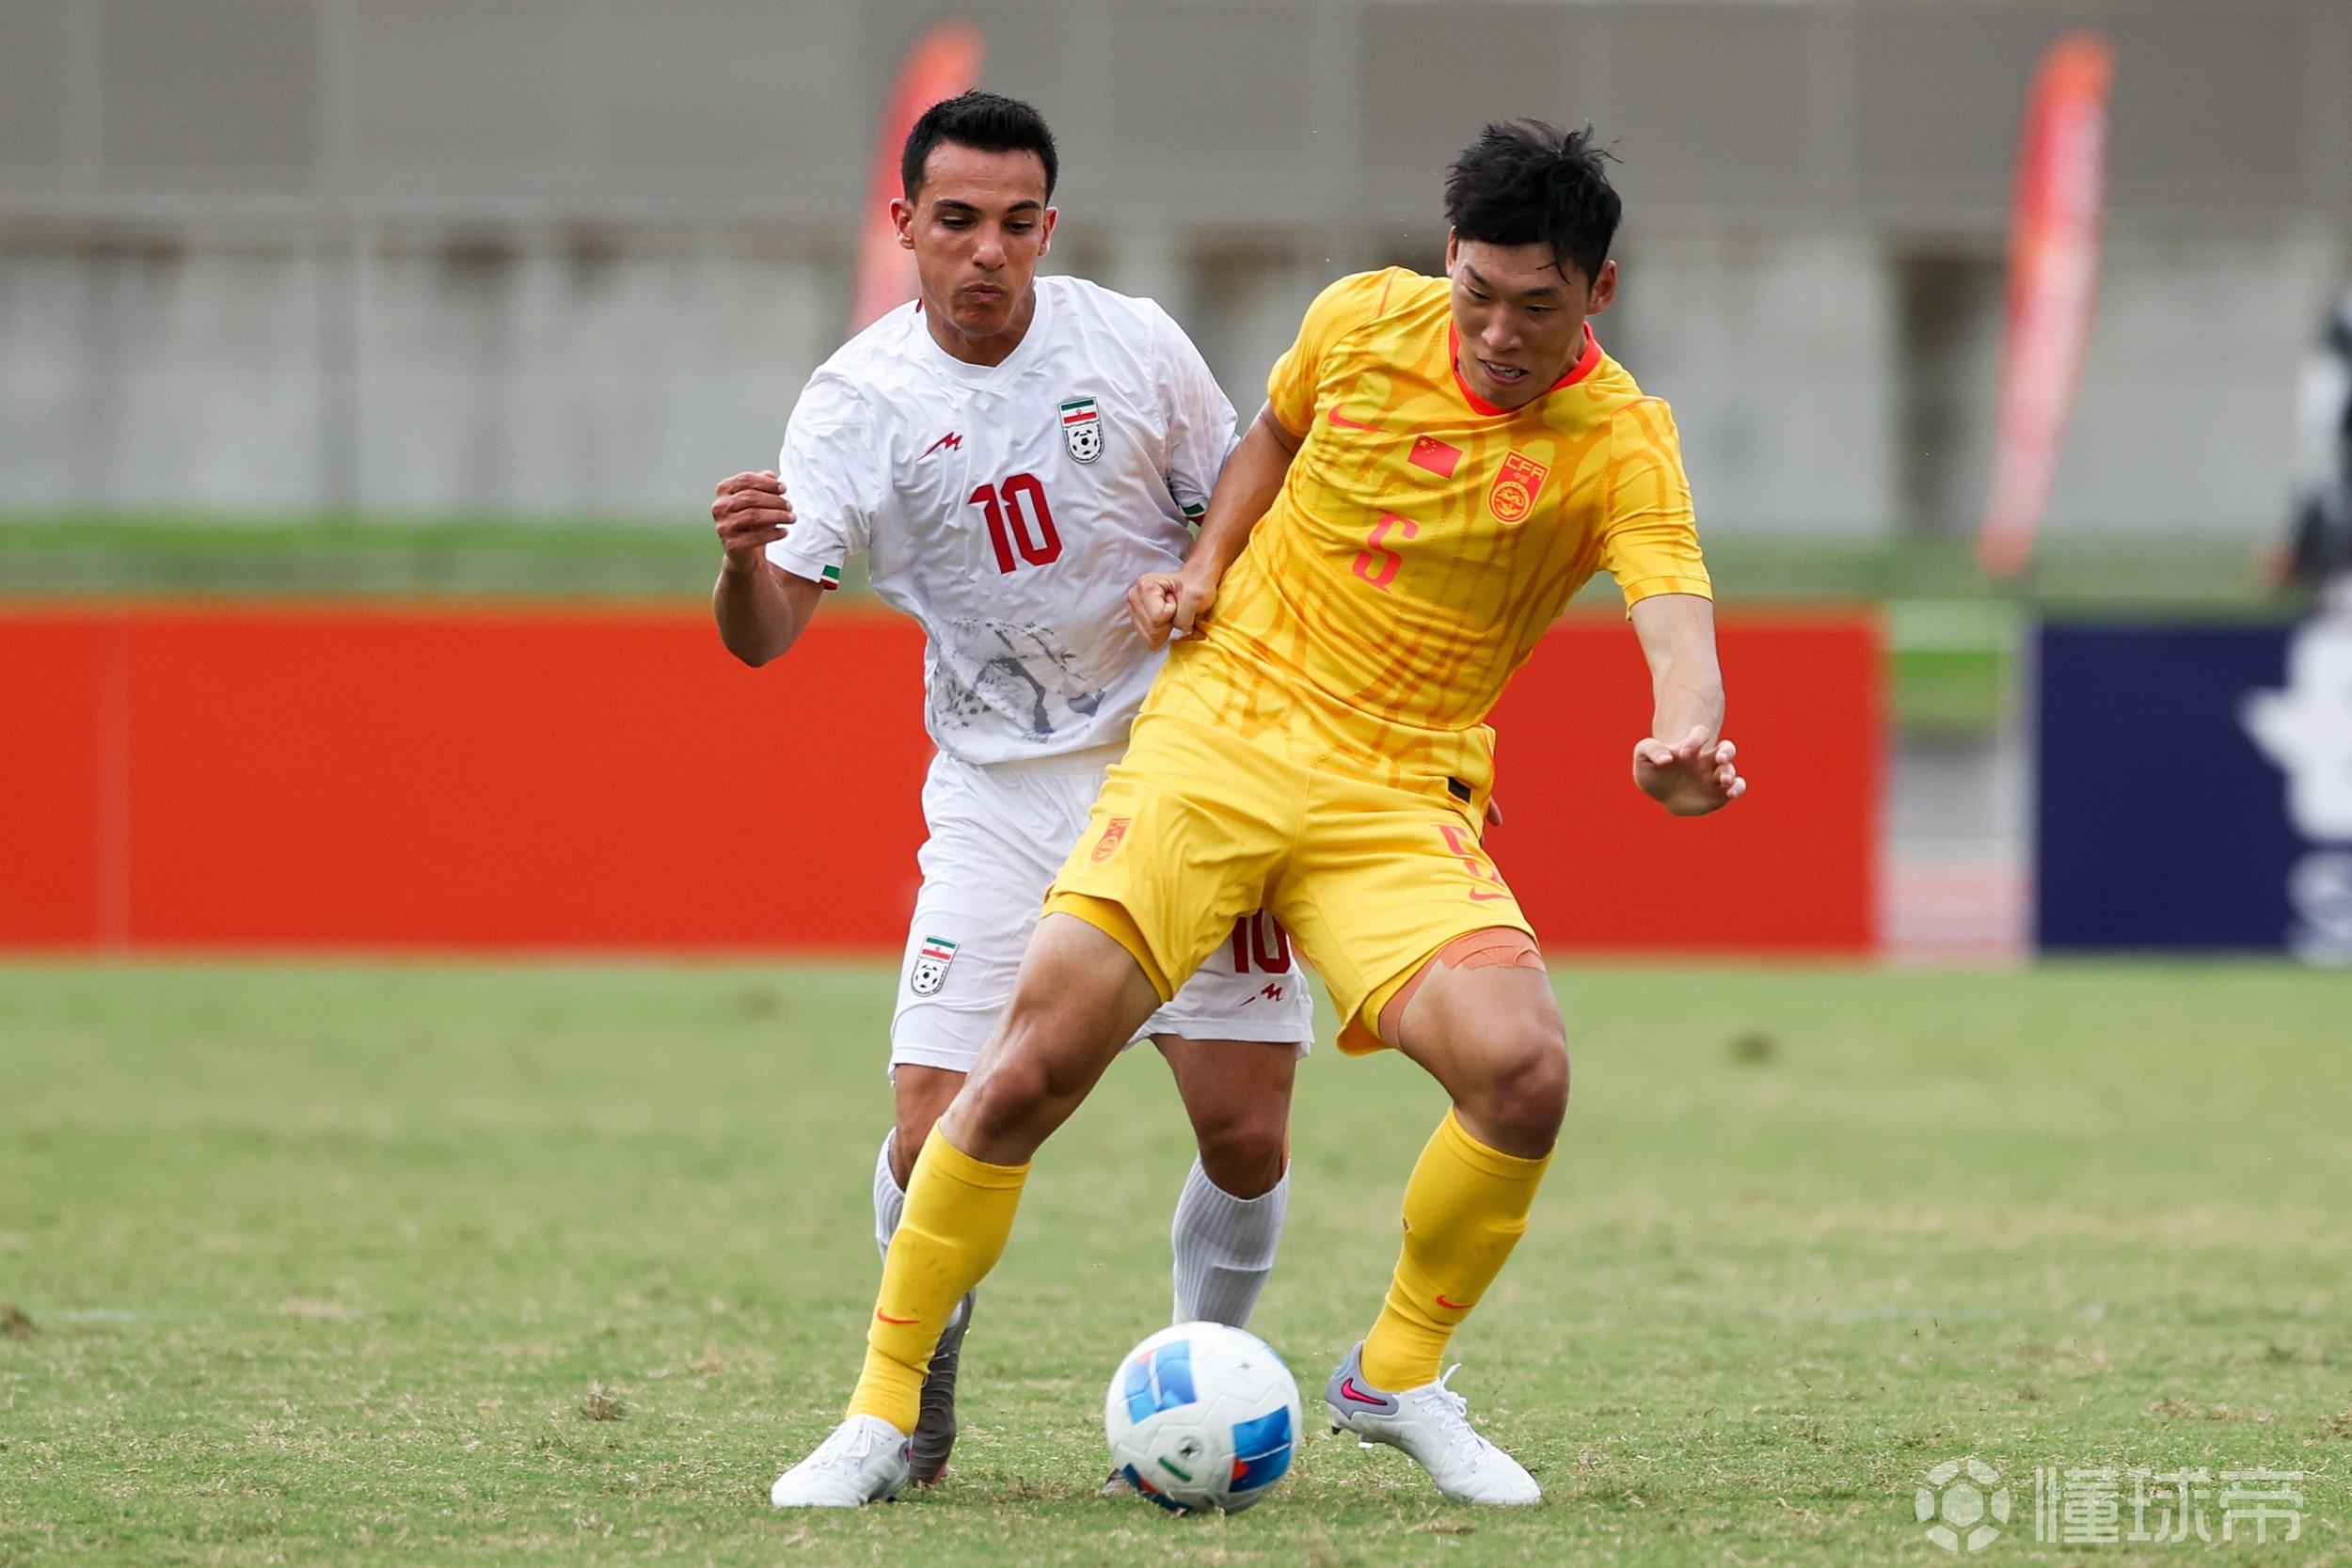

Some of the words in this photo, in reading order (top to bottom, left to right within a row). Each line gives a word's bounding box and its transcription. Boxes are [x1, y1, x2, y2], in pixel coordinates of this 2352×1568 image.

[1505, 454, 1546, 481] CFA
[967, 472, 1063, 575] 10
[1232, 907, 1292, 974] 10
